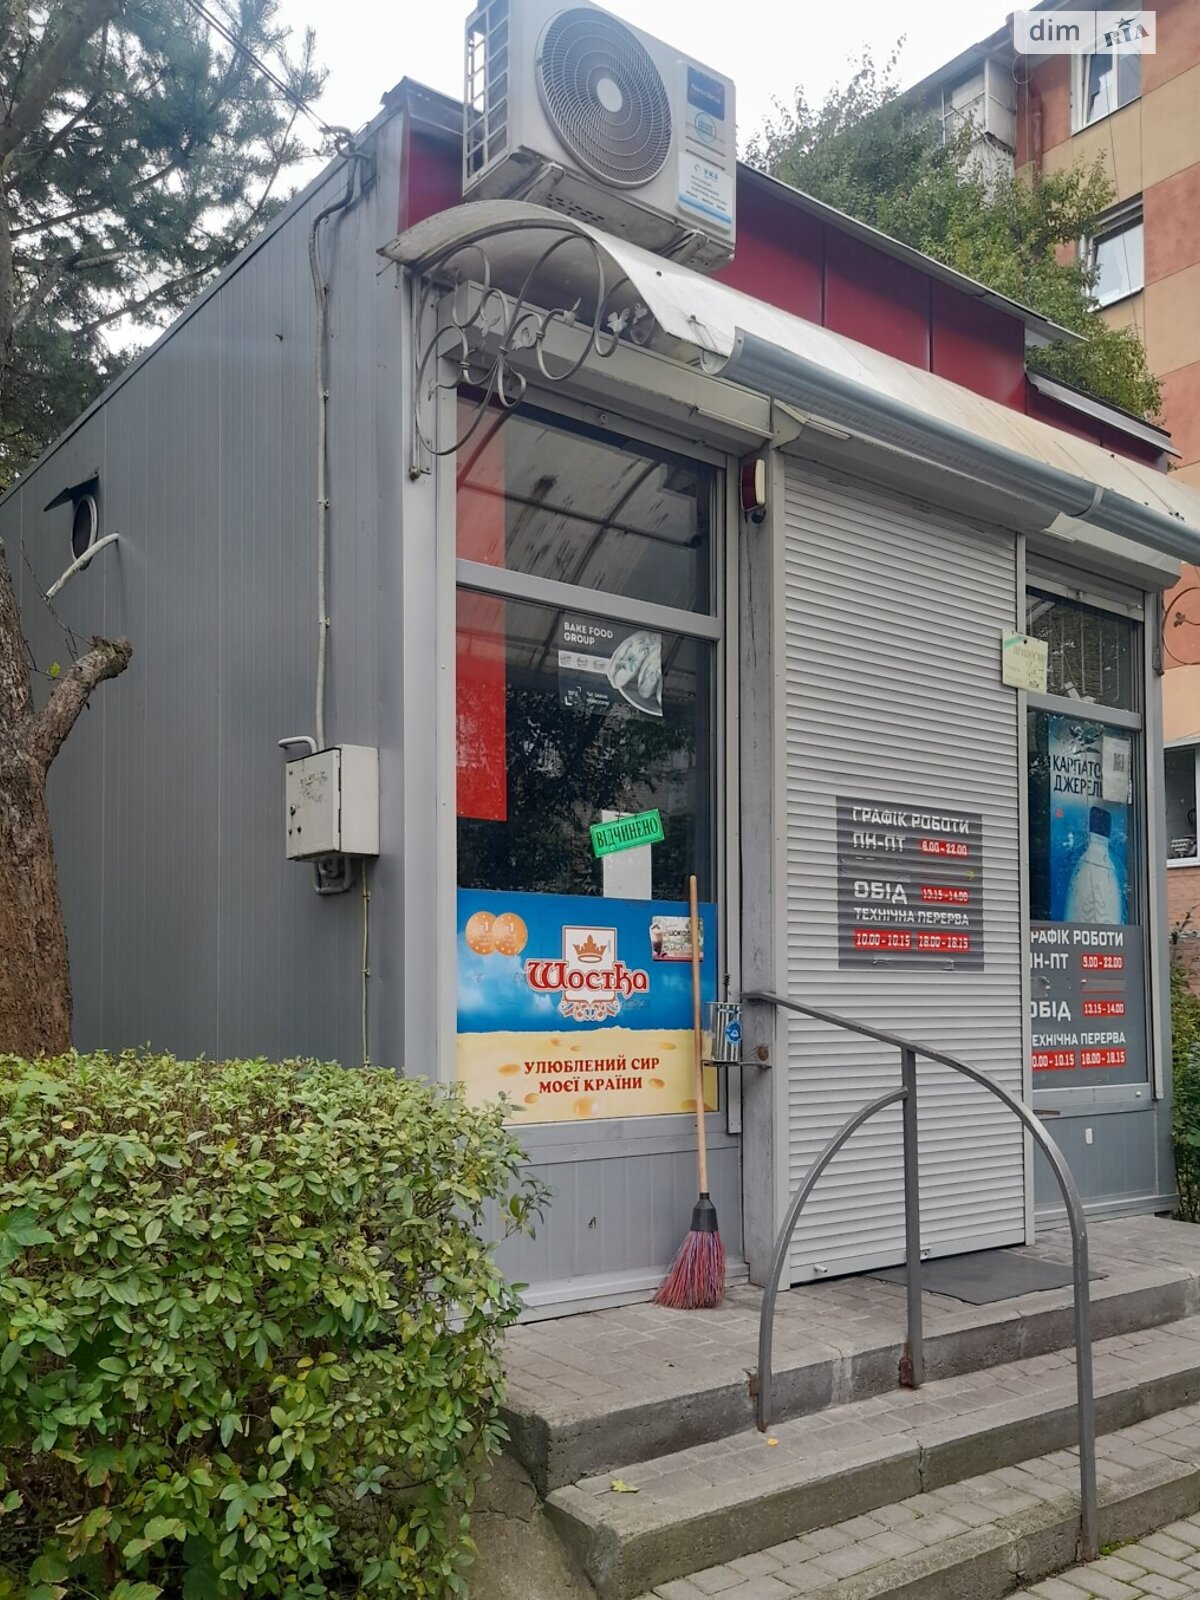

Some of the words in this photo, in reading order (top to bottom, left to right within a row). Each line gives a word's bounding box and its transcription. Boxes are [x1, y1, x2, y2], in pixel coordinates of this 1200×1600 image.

[563, 632, 595, 645] GROUP
[564, 621, 588, 634] BAKE
[588, 626, 614, 639] FOOD
[1053, 754, 1102, 779] КАРПАТС
[852, 805, 908, 828] ГРАФІК
[911, 813, 970, 834] РОБОТИ
[595, 817, 659, 848] ВІДЧИНЕНО
[853, 832, 906, 852] ПН-ПТ
[945, 843, 968, 856] 22.00
[853, 880, 908, 905] ОБІД
[948, 890, 969, 902] 14.00
[853, 907, 915, 924] ТЕХНІЧНА
[917, 911, 970, 926] ПЕРЕРВА
[856, 933, 881, 947] 10.00
[887, 934, 911, 948] 10.15
[1030, 928, 1070, 945] РАФІК
[1073, 930, 1124, 947] РОБОТИ
[1082, 955, 1098, 968] 9.00
[1103, 956, 1123, 969] 22.00
[527, 961, 648, 996] Шостка
[1084, 1003, 1102, 1014] 13.15
[1106, 1003, 1124, 1014] 14.00
[1031, 1032, 1079, 1047] ЕХНІЧНА
[1080, 1031, 1126, 1045] ПЕРЕРВА
[524, 1054, 627, 1075] УЛЮБЛЕНИЙ
[630, 1057, 660, 1070] СИР
[1031, 1055, 1049, 1068] 0.00
[1054, 1054, 1075, 1067] 10.15
[1081, 1053, 1101, 1065] 18.00
[1106, 1051, 1126, 1064] 18.15
[539, 1076, 581, 1094] МОЄЇ
[584, 1074, 643, 1092] КРАЇНИ
